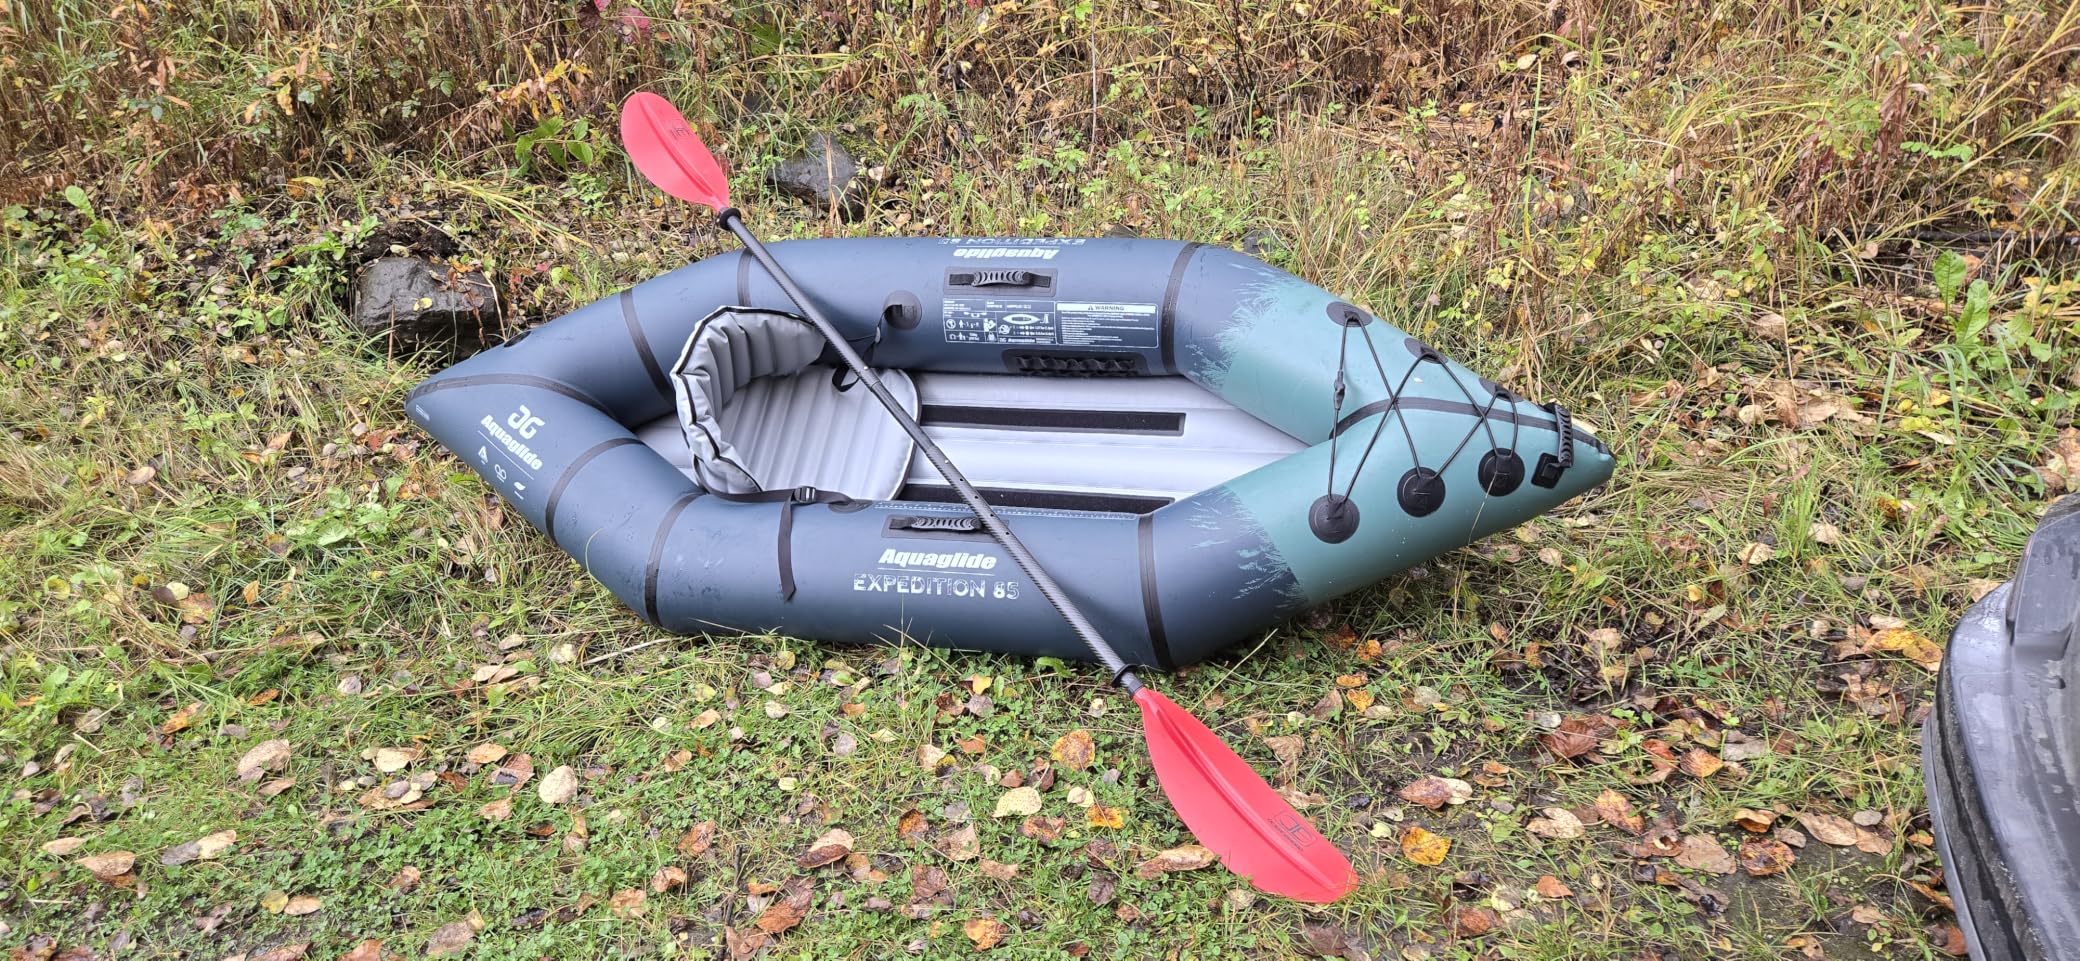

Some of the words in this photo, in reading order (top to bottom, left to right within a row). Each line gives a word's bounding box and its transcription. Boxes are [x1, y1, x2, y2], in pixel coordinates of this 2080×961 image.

[967, 238, 1087, 246] EXPEDITION
[953, 248, 1061, 260] Aquaglide
[480, 414, 543, 471] Aquaglide
[878, 548, 998, 570] Aquaglide
[853, 573, 986, 598] EXPEDITION
[992, 580, 1021, 600] 85
